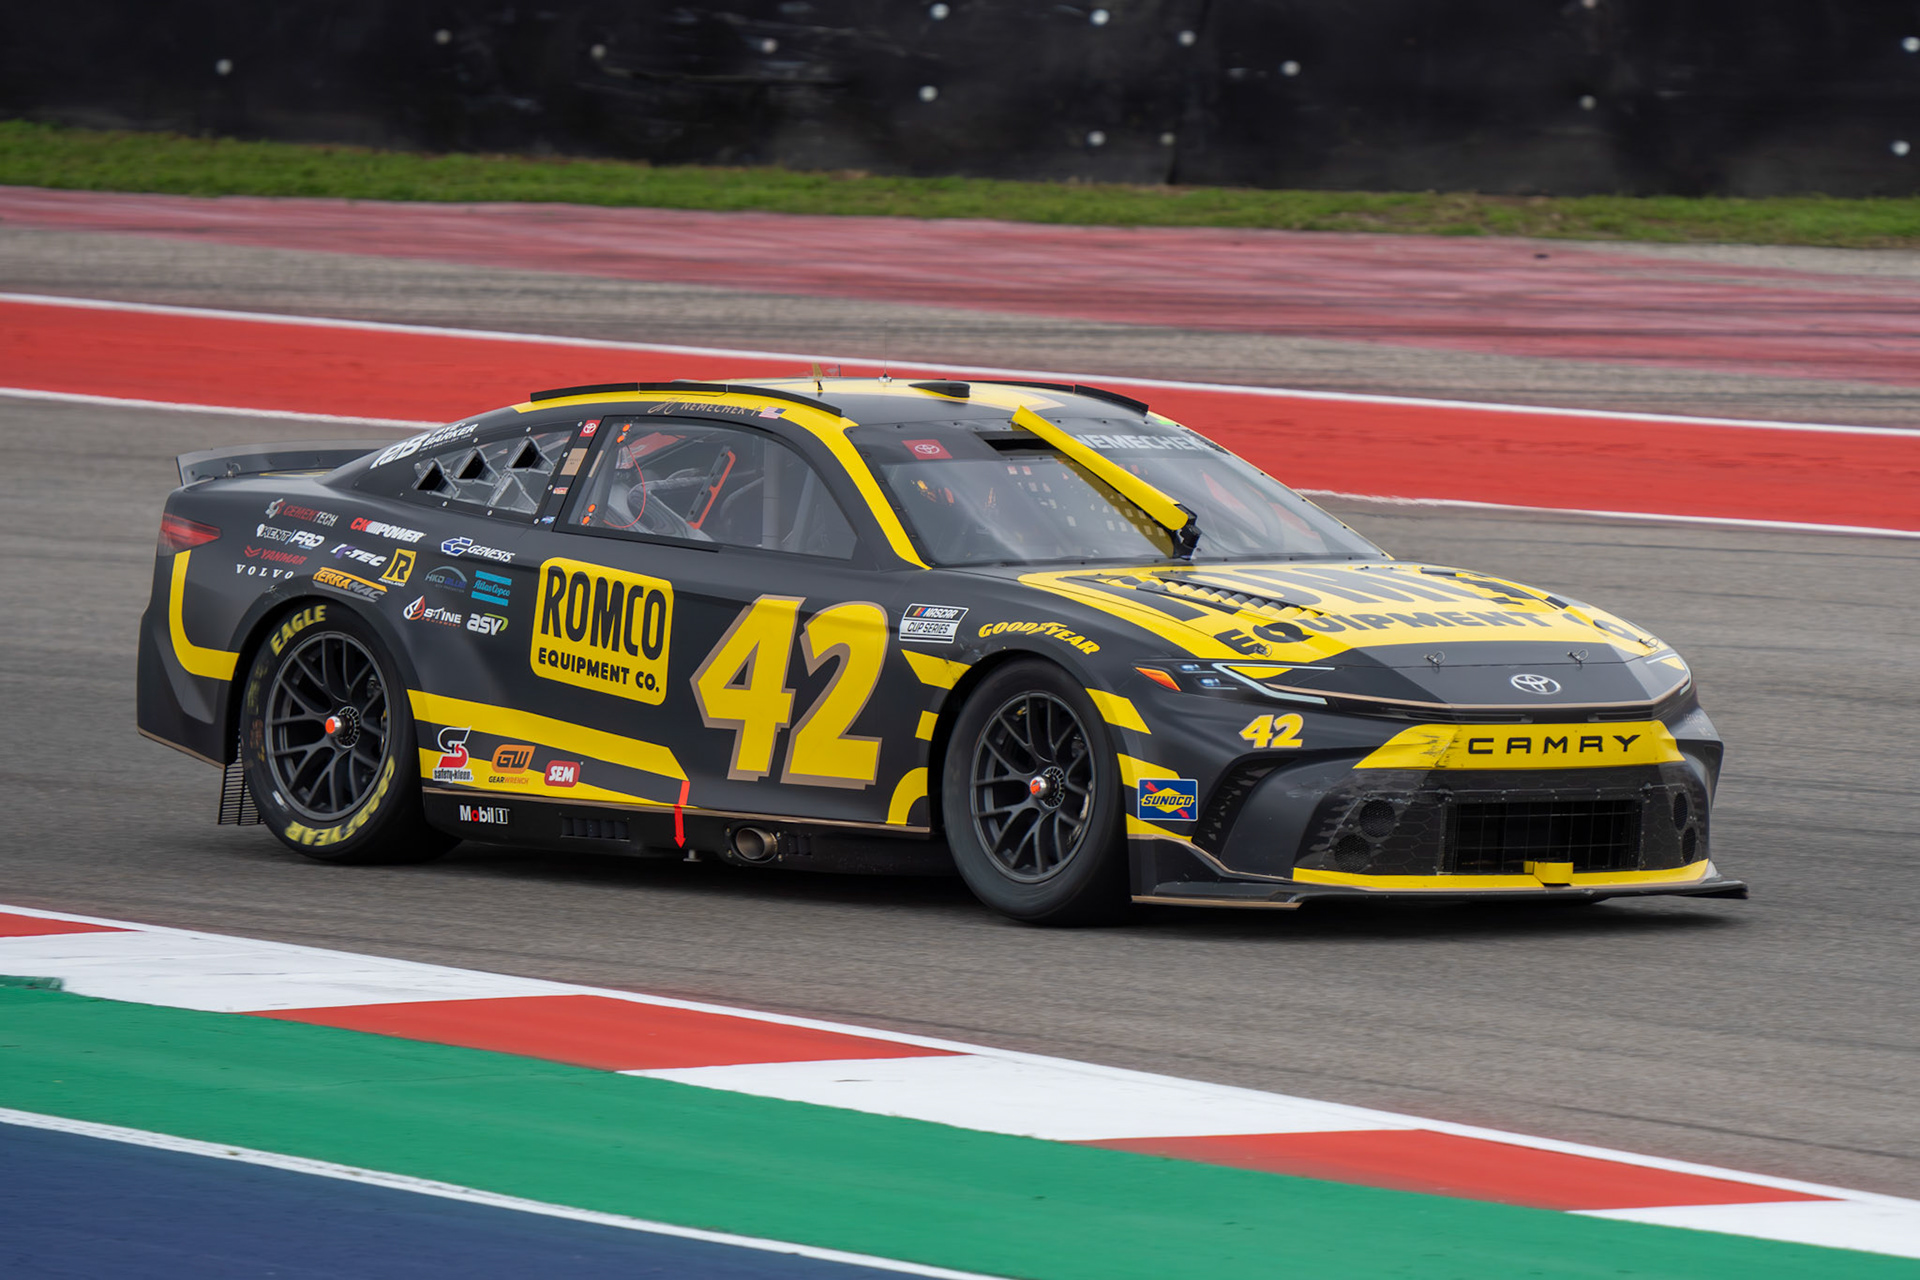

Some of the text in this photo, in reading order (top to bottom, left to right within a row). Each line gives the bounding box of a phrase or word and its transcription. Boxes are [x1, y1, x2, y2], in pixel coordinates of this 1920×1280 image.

[680, 401, 746, 416] NEMECHEK
[261, 549, 308, 566] YANMAR
[467, 545, 516, 563] GENESIS
[236, 563, 295, 580] VOLVO
[473, 579, 493, 593] Atlas
[491, 584, 511, 597] Copco
[541, 565, 667, 661] ROMCO
[922, 607, 959, 620] NASCAR
[270, 604, 327, 656] EAGLE
[907, 621, 950, 634] CUP SERIES
[978, 621, 1101, 655] GOODYEAR
[538, 647, 660, 693] EQUIPMENT CO.
[690, 593, 890, 790] 42
[1238, 713, 1304, 748] 42
[1467, 733, 1642, 756] CAMRY
[488, 775, 529, 785] GEARWRENCH
[548, 765, 575, 783] SEM
[1142, 794, 1195, 807] SUNOCO
[459, 804, 494, 823] Mobil
